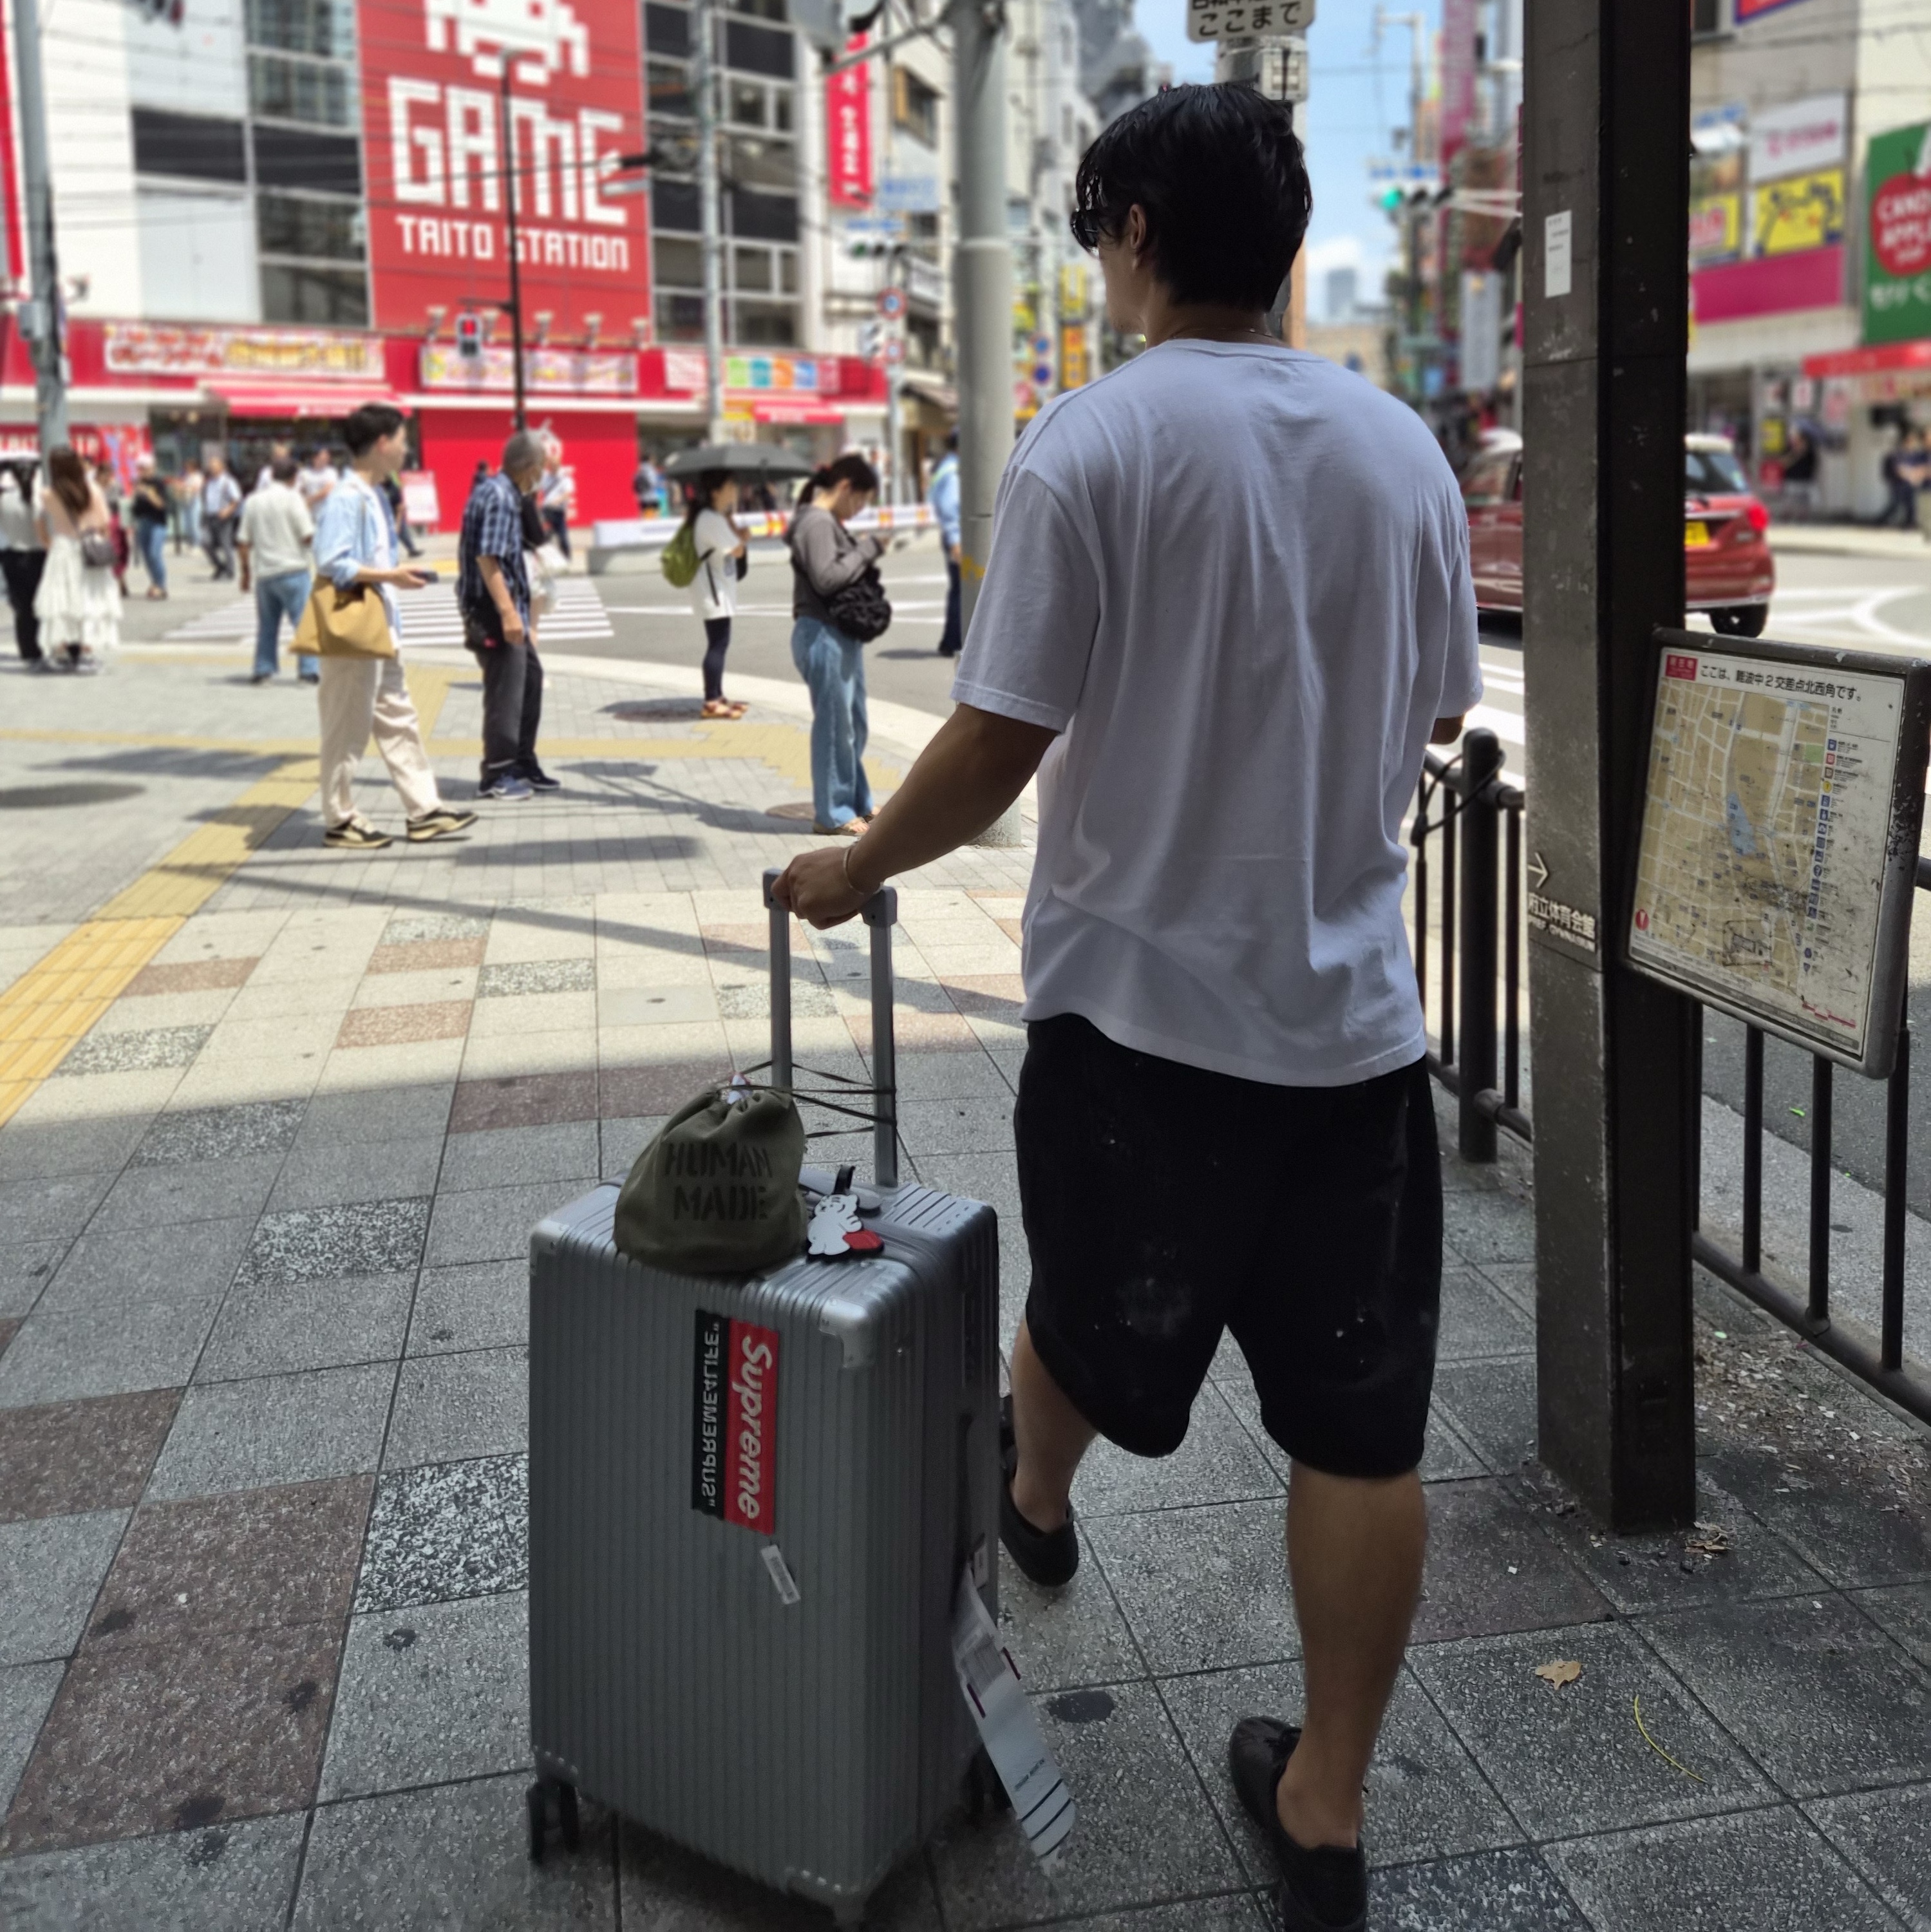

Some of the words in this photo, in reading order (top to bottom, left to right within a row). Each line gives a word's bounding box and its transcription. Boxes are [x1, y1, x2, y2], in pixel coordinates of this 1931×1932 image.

[1199, 1, 1301, 37] ここまで
[388, 75, 626, 225] GAME
[395, 214, 495, 260] TAITO
[504, 227, 630, 272] STATION
[664, 1141, 773, 1179] HUMAN
[673, 1186, 768, 1220] MADE
[731, 1335, 773, 1519] Supreme
